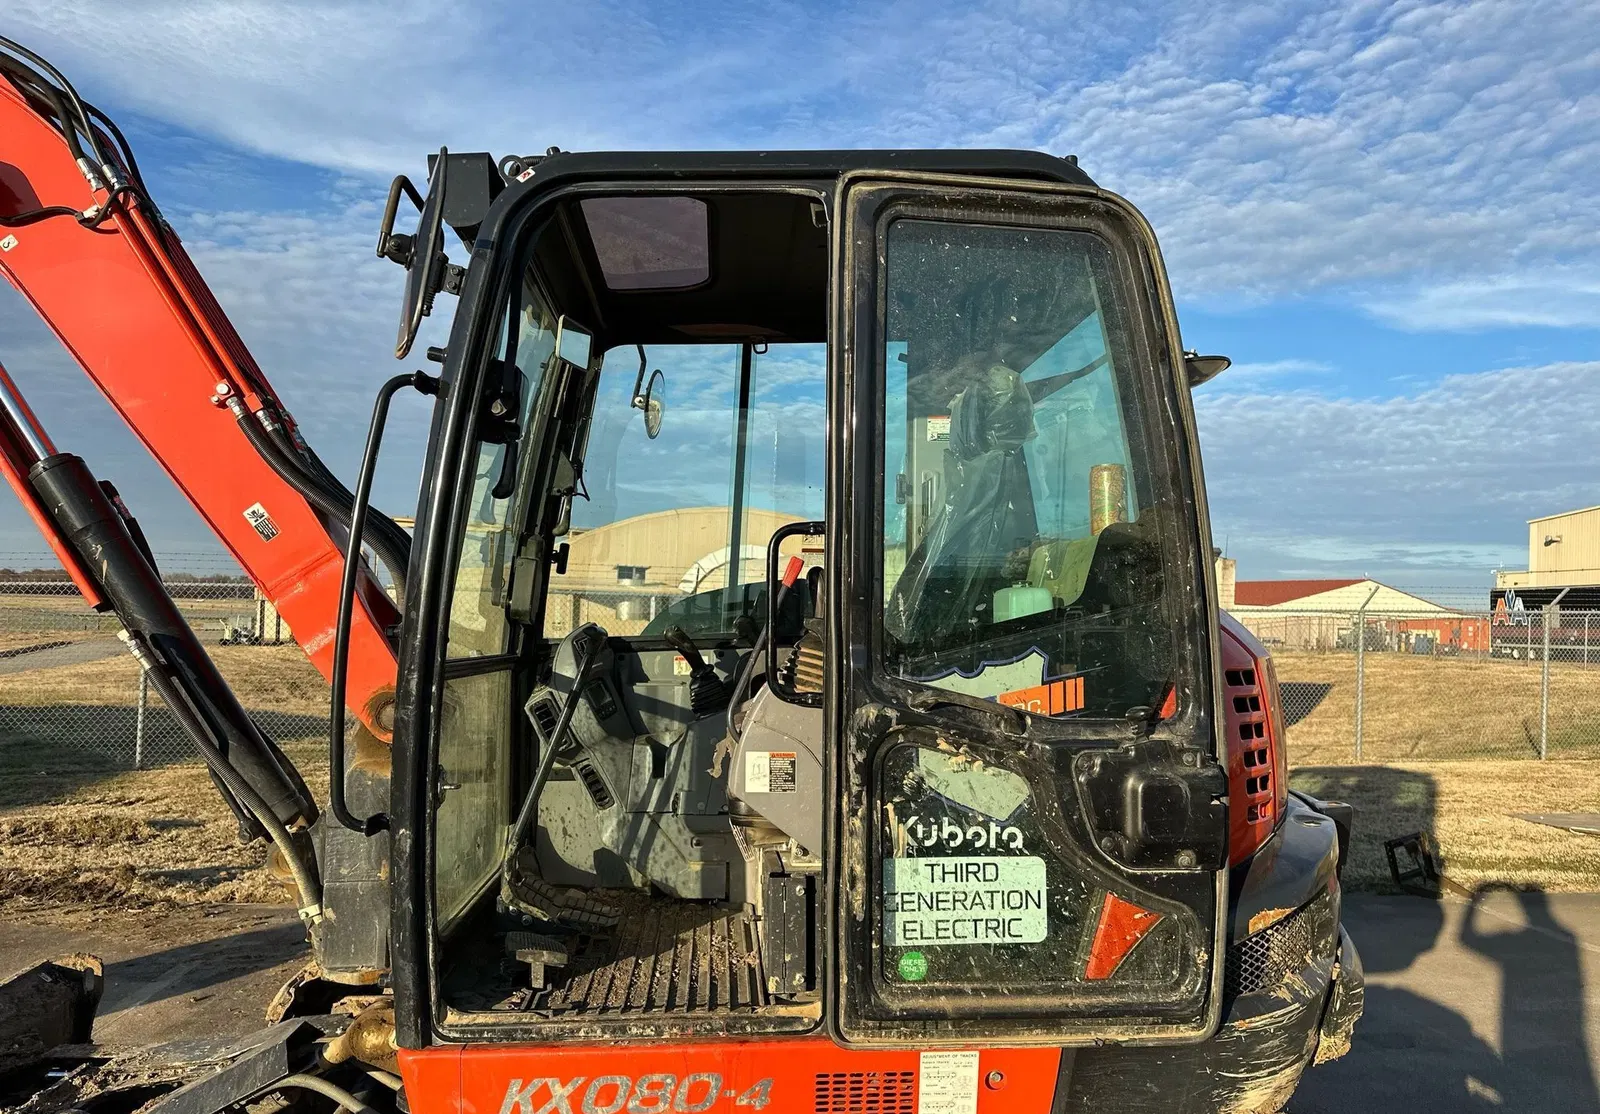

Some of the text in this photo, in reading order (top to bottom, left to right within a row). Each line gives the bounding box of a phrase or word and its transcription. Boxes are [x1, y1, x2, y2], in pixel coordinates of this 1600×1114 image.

[896, 815, 1024, 849] Kubota
[924, 862, 999, 883] THIRD
[884, 889, 1042, 913] GENERATION
[902, 917, 1023, 941] ELECTRIC
[499, 1072, 775, 1114] KX080-4
